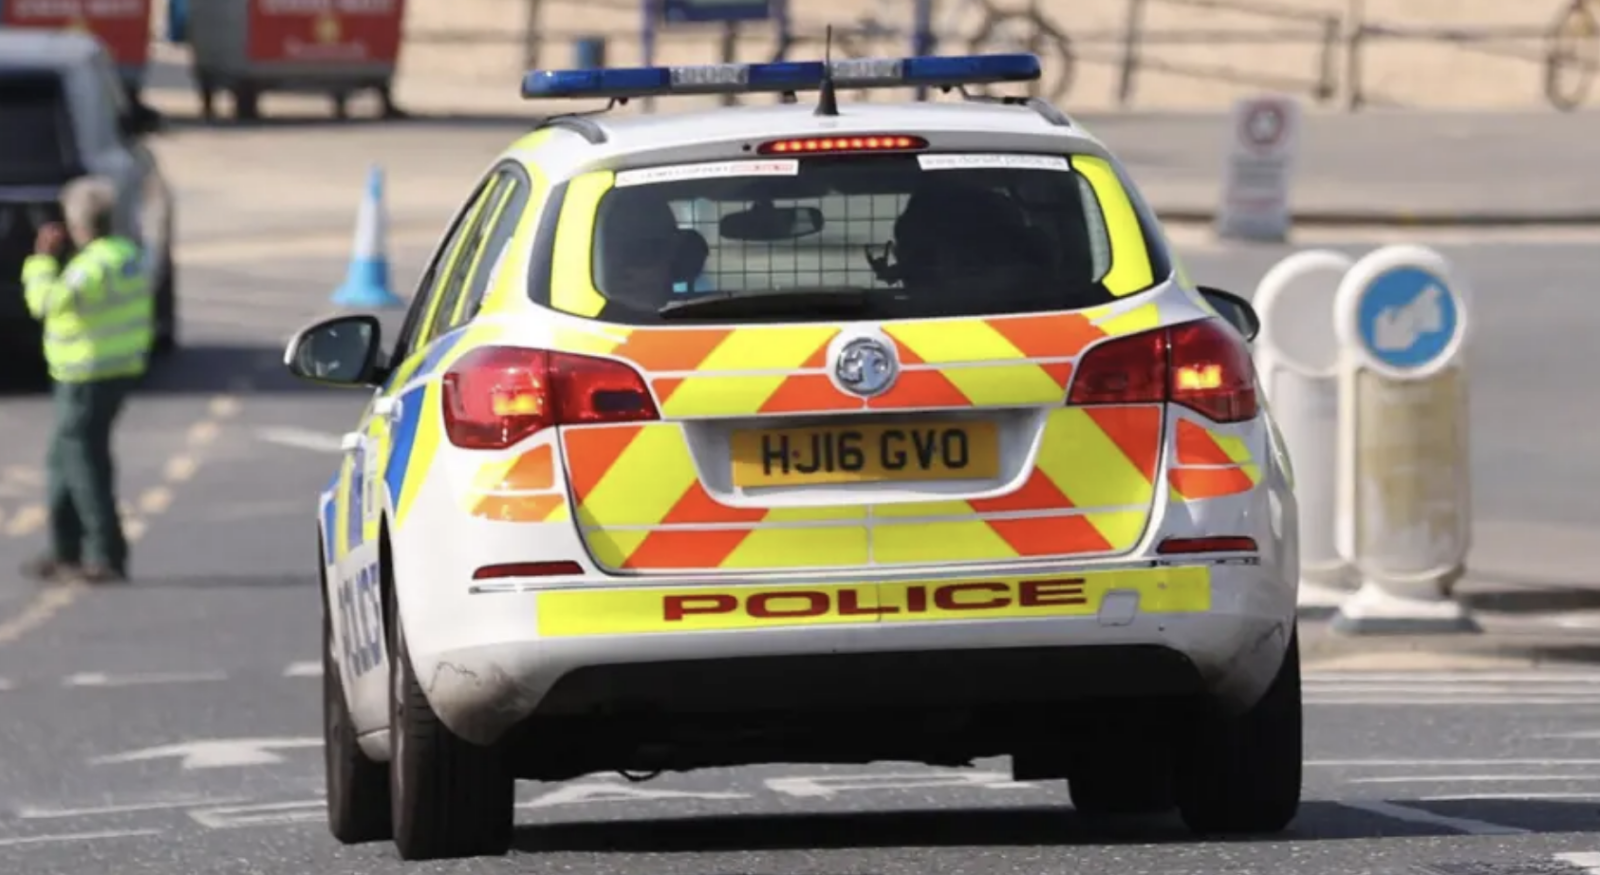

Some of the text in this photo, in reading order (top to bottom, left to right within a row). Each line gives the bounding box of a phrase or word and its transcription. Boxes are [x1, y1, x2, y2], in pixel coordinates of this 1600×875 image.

[761, 429, 969, 476] HJ16 GVO
[662, 578, 1088, 621] POLICE
